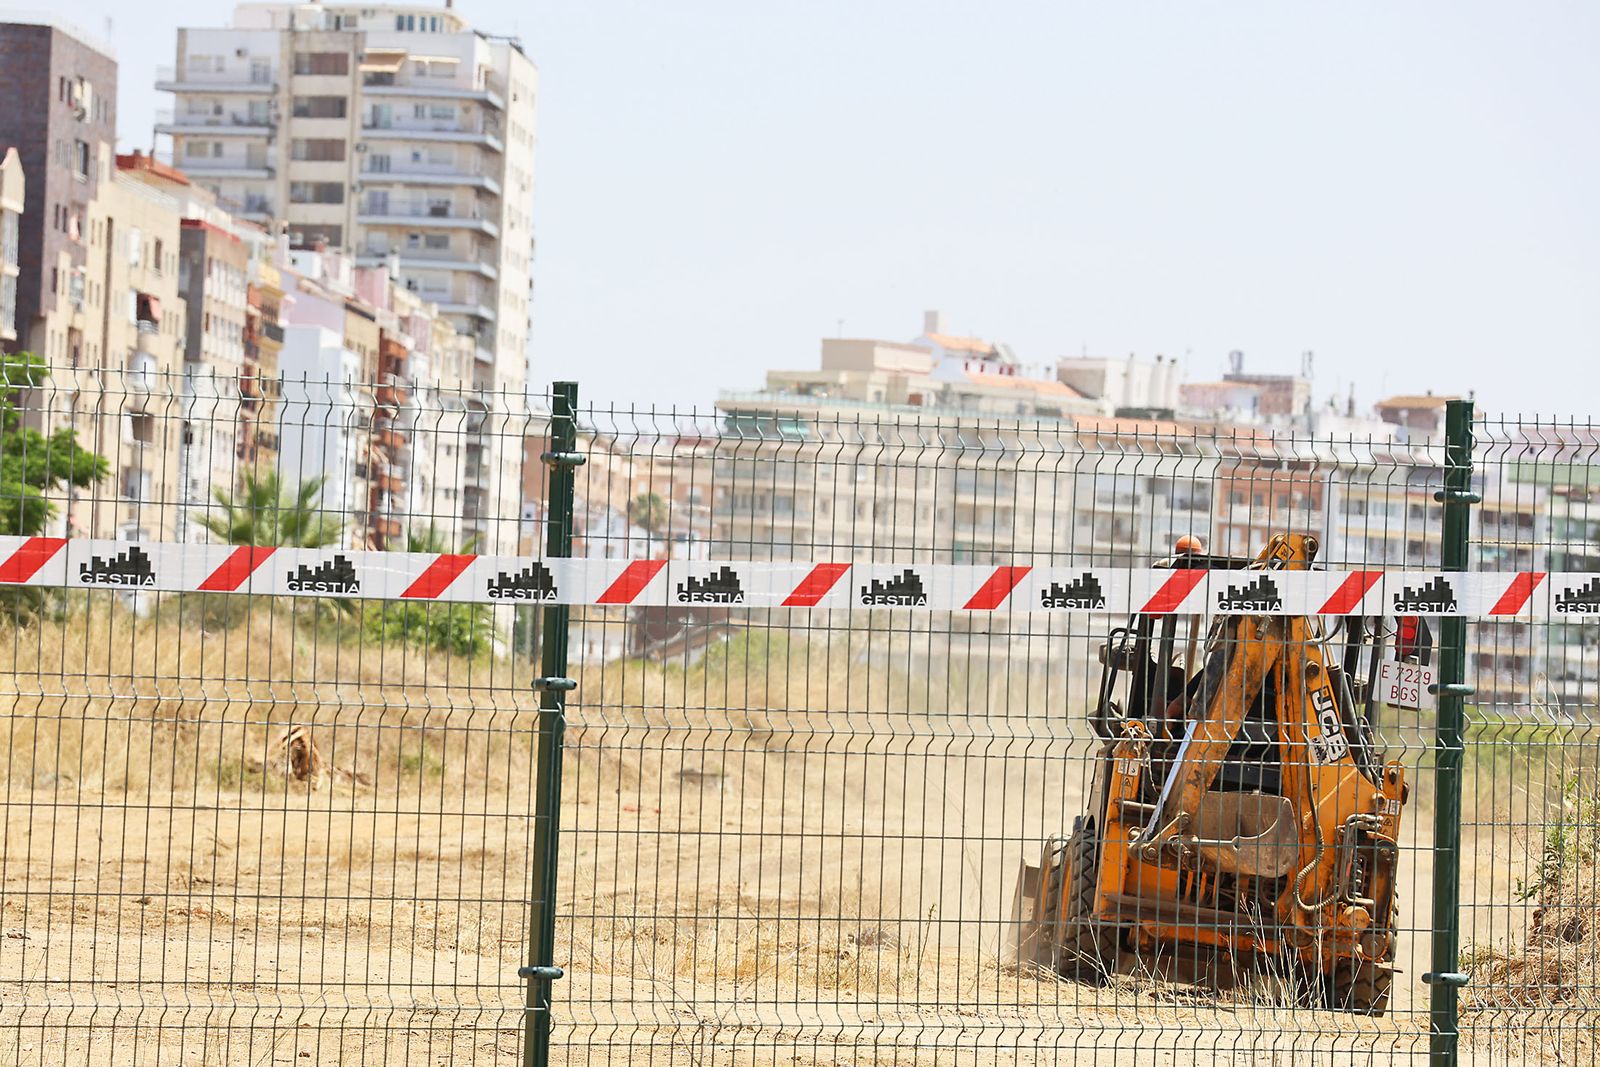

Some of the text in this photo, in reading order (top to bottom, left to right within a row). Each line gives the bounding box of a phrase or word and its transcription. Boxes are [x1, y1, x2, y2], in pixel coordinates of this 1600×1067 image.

[79, 572, 155, 585] GESTIA
[286, 580, 360, 593] GESTIA
[487, 587, 557, 600] GESTIA
[676, 591, 744, 603] GESTIA
[860, 594, 927, 606] GESTIA
[1041, 597, 1105, 609] GESTIA
[1217, 600, 1282, 611] GESTIA
[1393, 601, 1457, 613] GESTIA
[1381, 664, 1432, 686] E 7229
[1390, 685, 1418, 702] BGS
[1311, 690, 1347, 762] JCB
